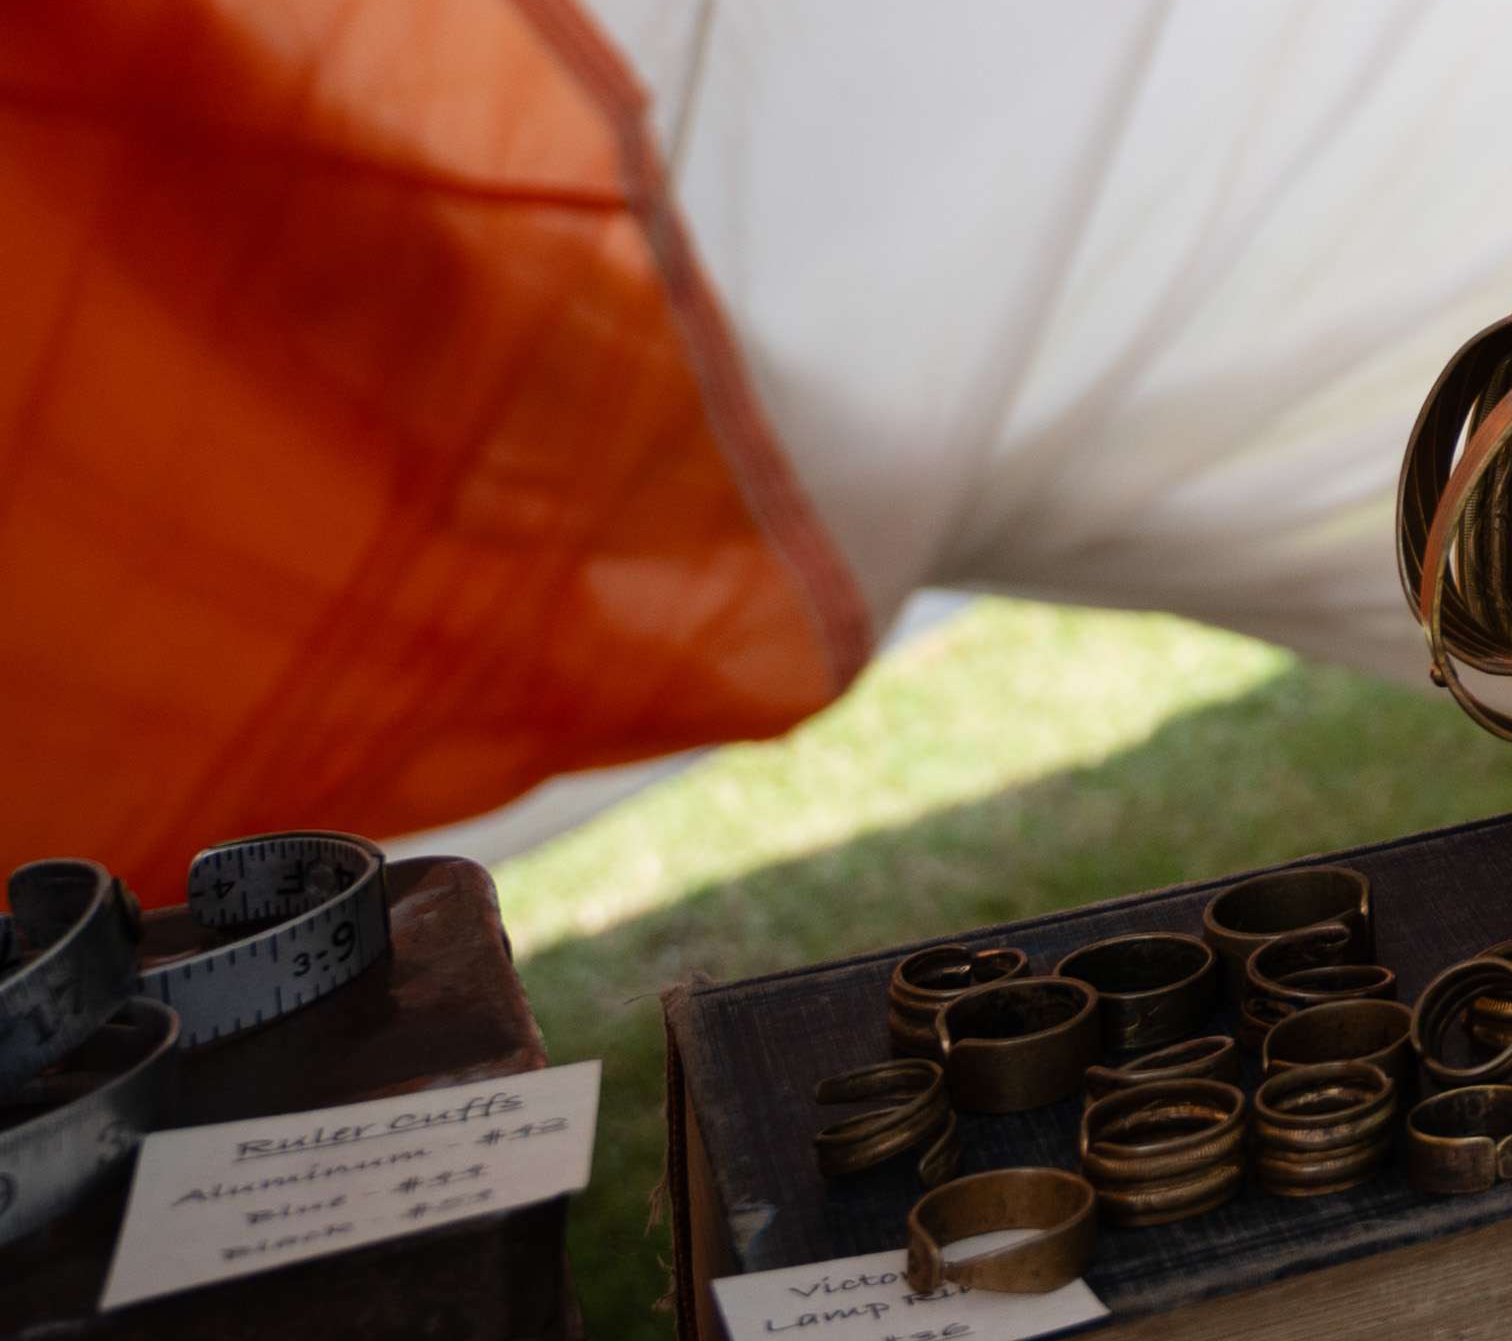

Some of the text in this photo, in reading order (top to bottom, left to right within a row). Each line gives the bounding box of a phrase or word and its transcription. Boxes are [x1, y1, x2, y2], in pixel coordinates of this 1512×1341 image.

[235, 1092, 525, 1161] Ruler Cuffs
[172, 1145, 432, 1207] Aluminum
[246, 1193, 348, 1225] Blue
[222, 1220, 355, 1262] Black
[766, 1299, 890, 1332] Lamp
